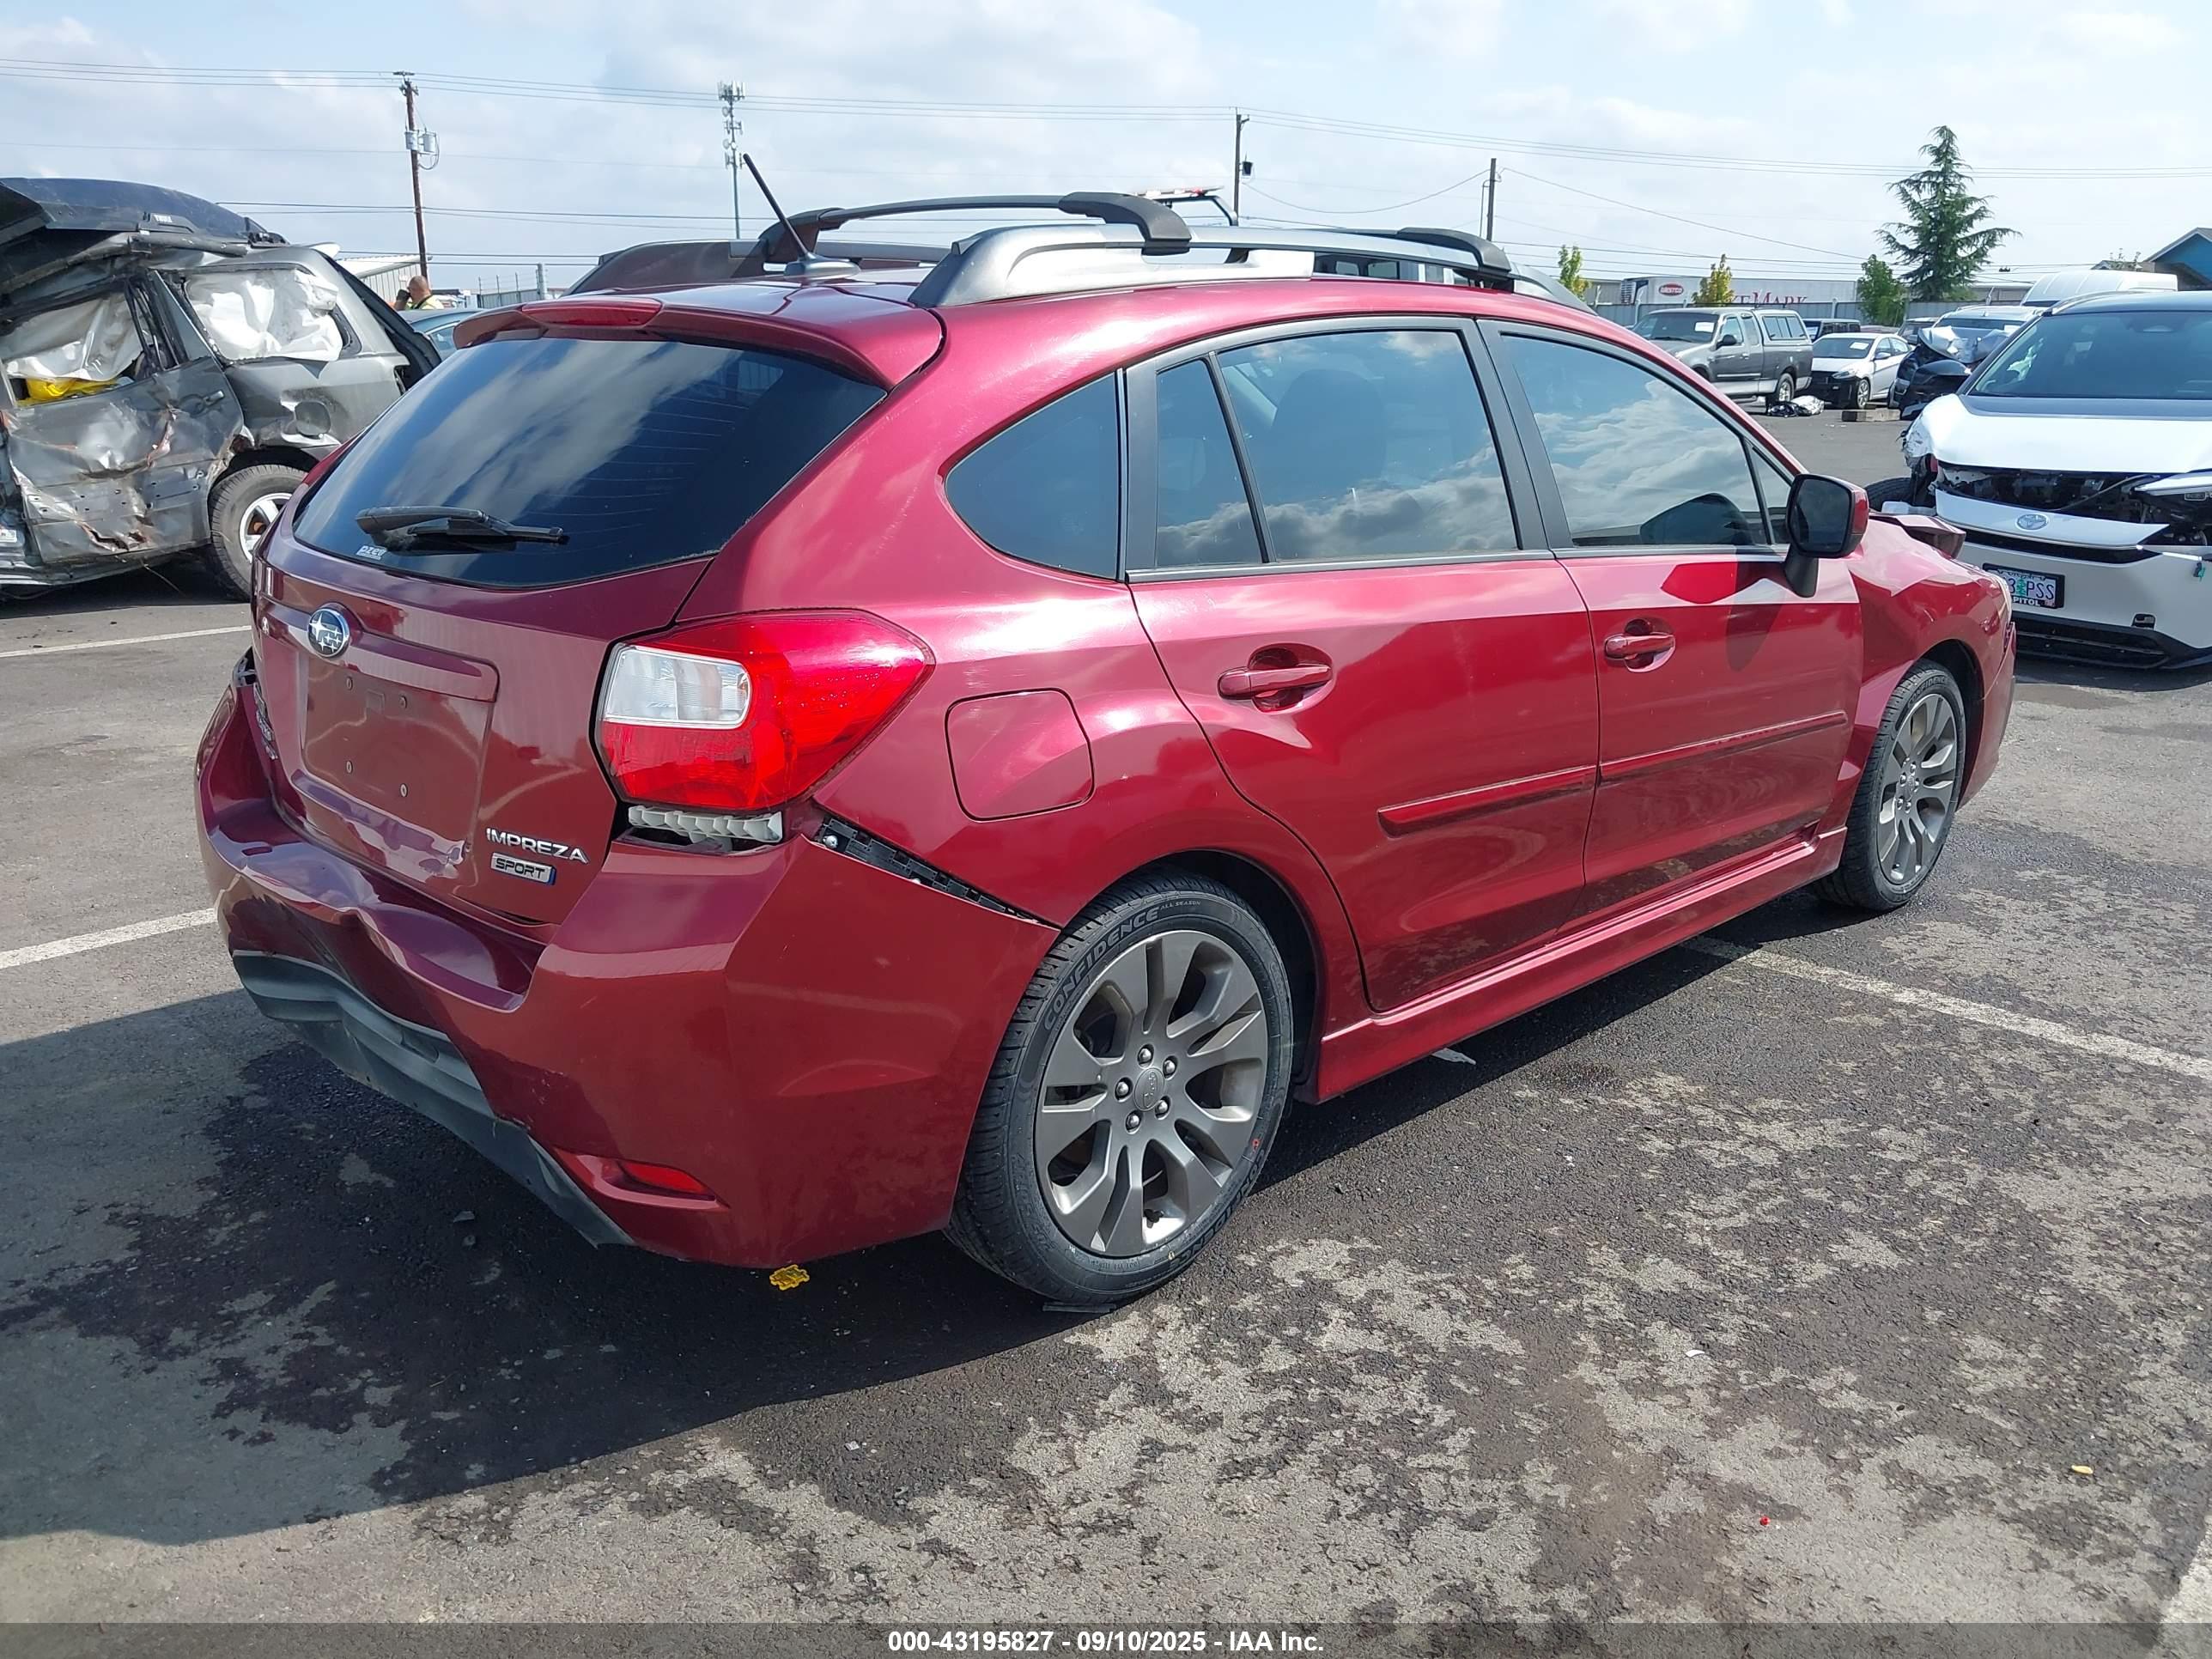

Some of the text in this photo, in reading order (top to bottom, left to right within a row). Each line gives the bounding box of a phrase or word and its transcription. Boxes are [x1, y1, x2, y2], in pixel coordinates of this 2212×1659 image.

[2013, 596, 2041, 606] PITOL
[486, 827, 589, 864] IMPREZA
[495, 858, 545, 879] SPORT
[1044, 907, 1159, 1030] CONFIDENCE
